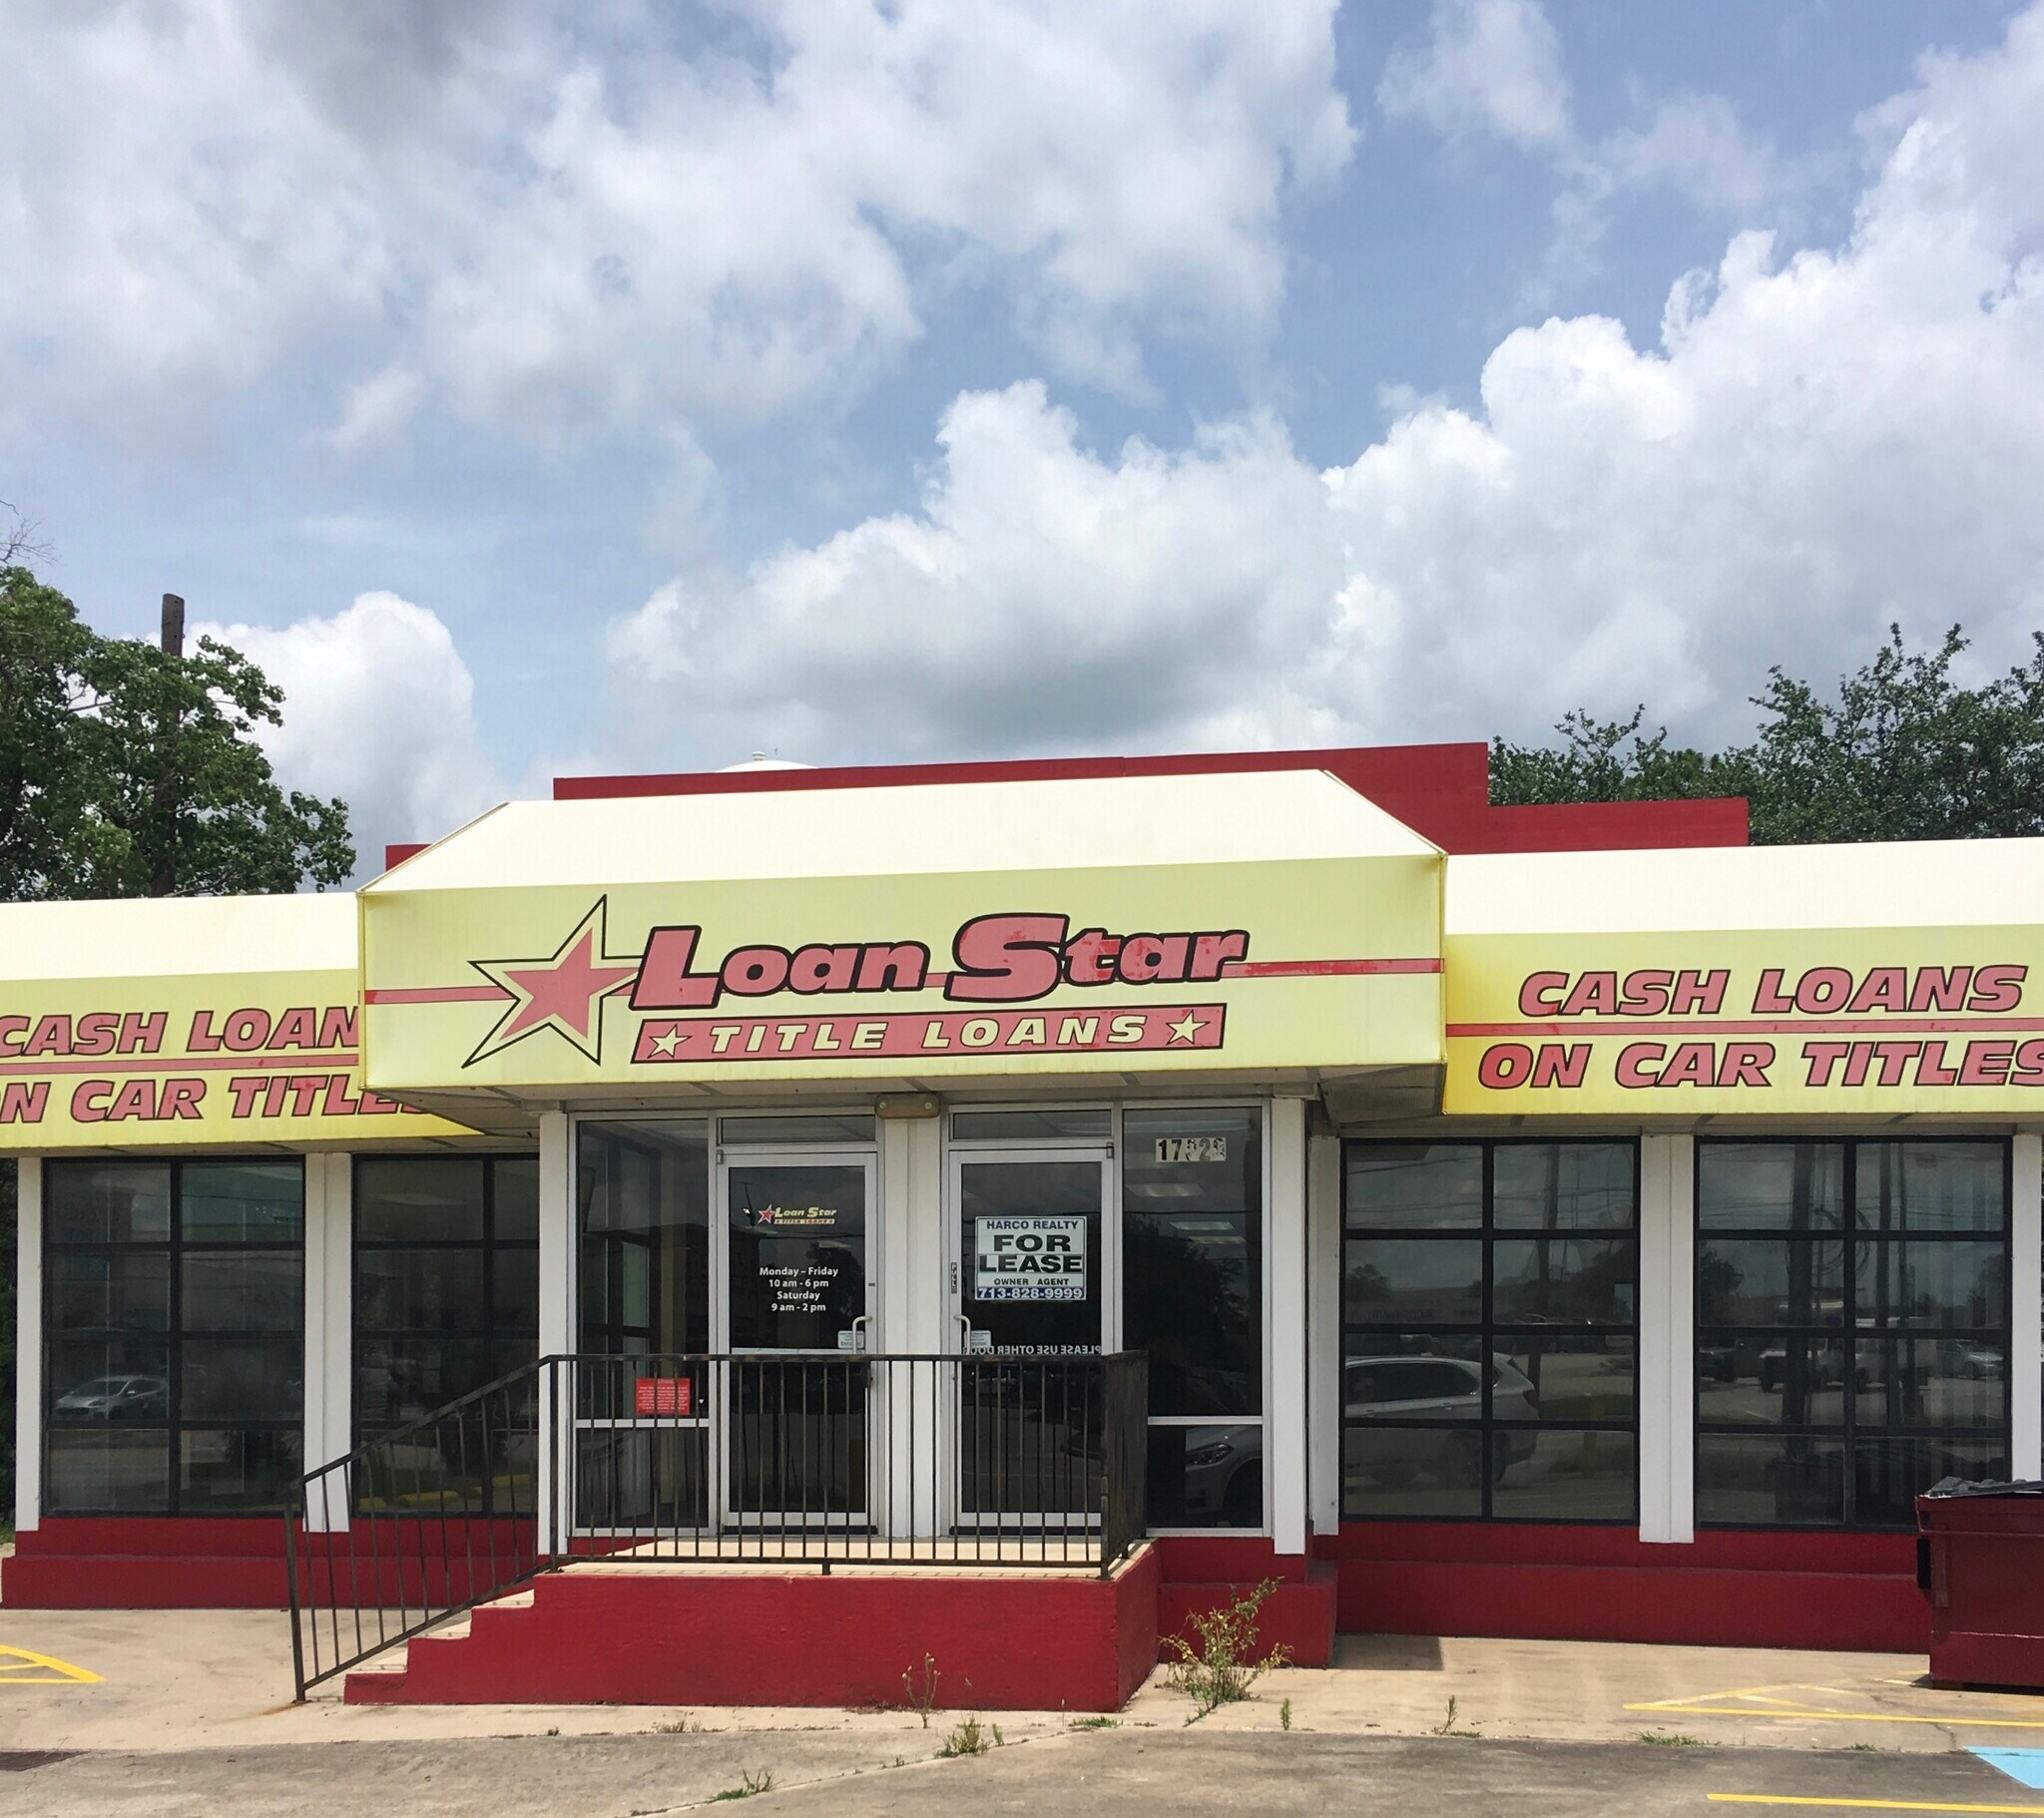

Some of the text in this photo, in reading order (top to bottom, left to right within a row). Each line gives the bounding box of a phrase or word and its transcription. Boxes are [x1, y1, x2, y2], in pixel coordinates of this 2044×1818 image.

[629, 913, 1249, 1010] Loan Star
[1519, 964, 2028, 1017] CASH LOANS
[0, 1012, 169, 1057] CASH
[709, 1015, 1149, 1055] TITLE LOANS
[1478, 1039, 2044, 1089] ON CAR TITLES
[0, 1082, 51, 1124] N
[70, 1078, 207, 1124] CAR
[774, 1206, 837, 1218] Loan Star
[987, 1220, 1079, 1230] HARCO REALTY
[993, 1234, 1071, 1252] FOR
[760, 1266, 799, 1277] Monday
[808, 1266, 838, 1277] Friday
[979, 1254, 1082, 1273] LEASE
[768, 1279, 780, 1288] 10
[804, 1279, 811, 1288] 6
[813, 1281, 829, 1290] pm
[979, 1287, 1083, 1299] 713-828-9999
[776, 1291, 820, 1301] Saturday
[771, 1303, 777, 1312] 9
[802, 1303, 808, 1312] 2
[810, 1305, 826, 1314] pm
